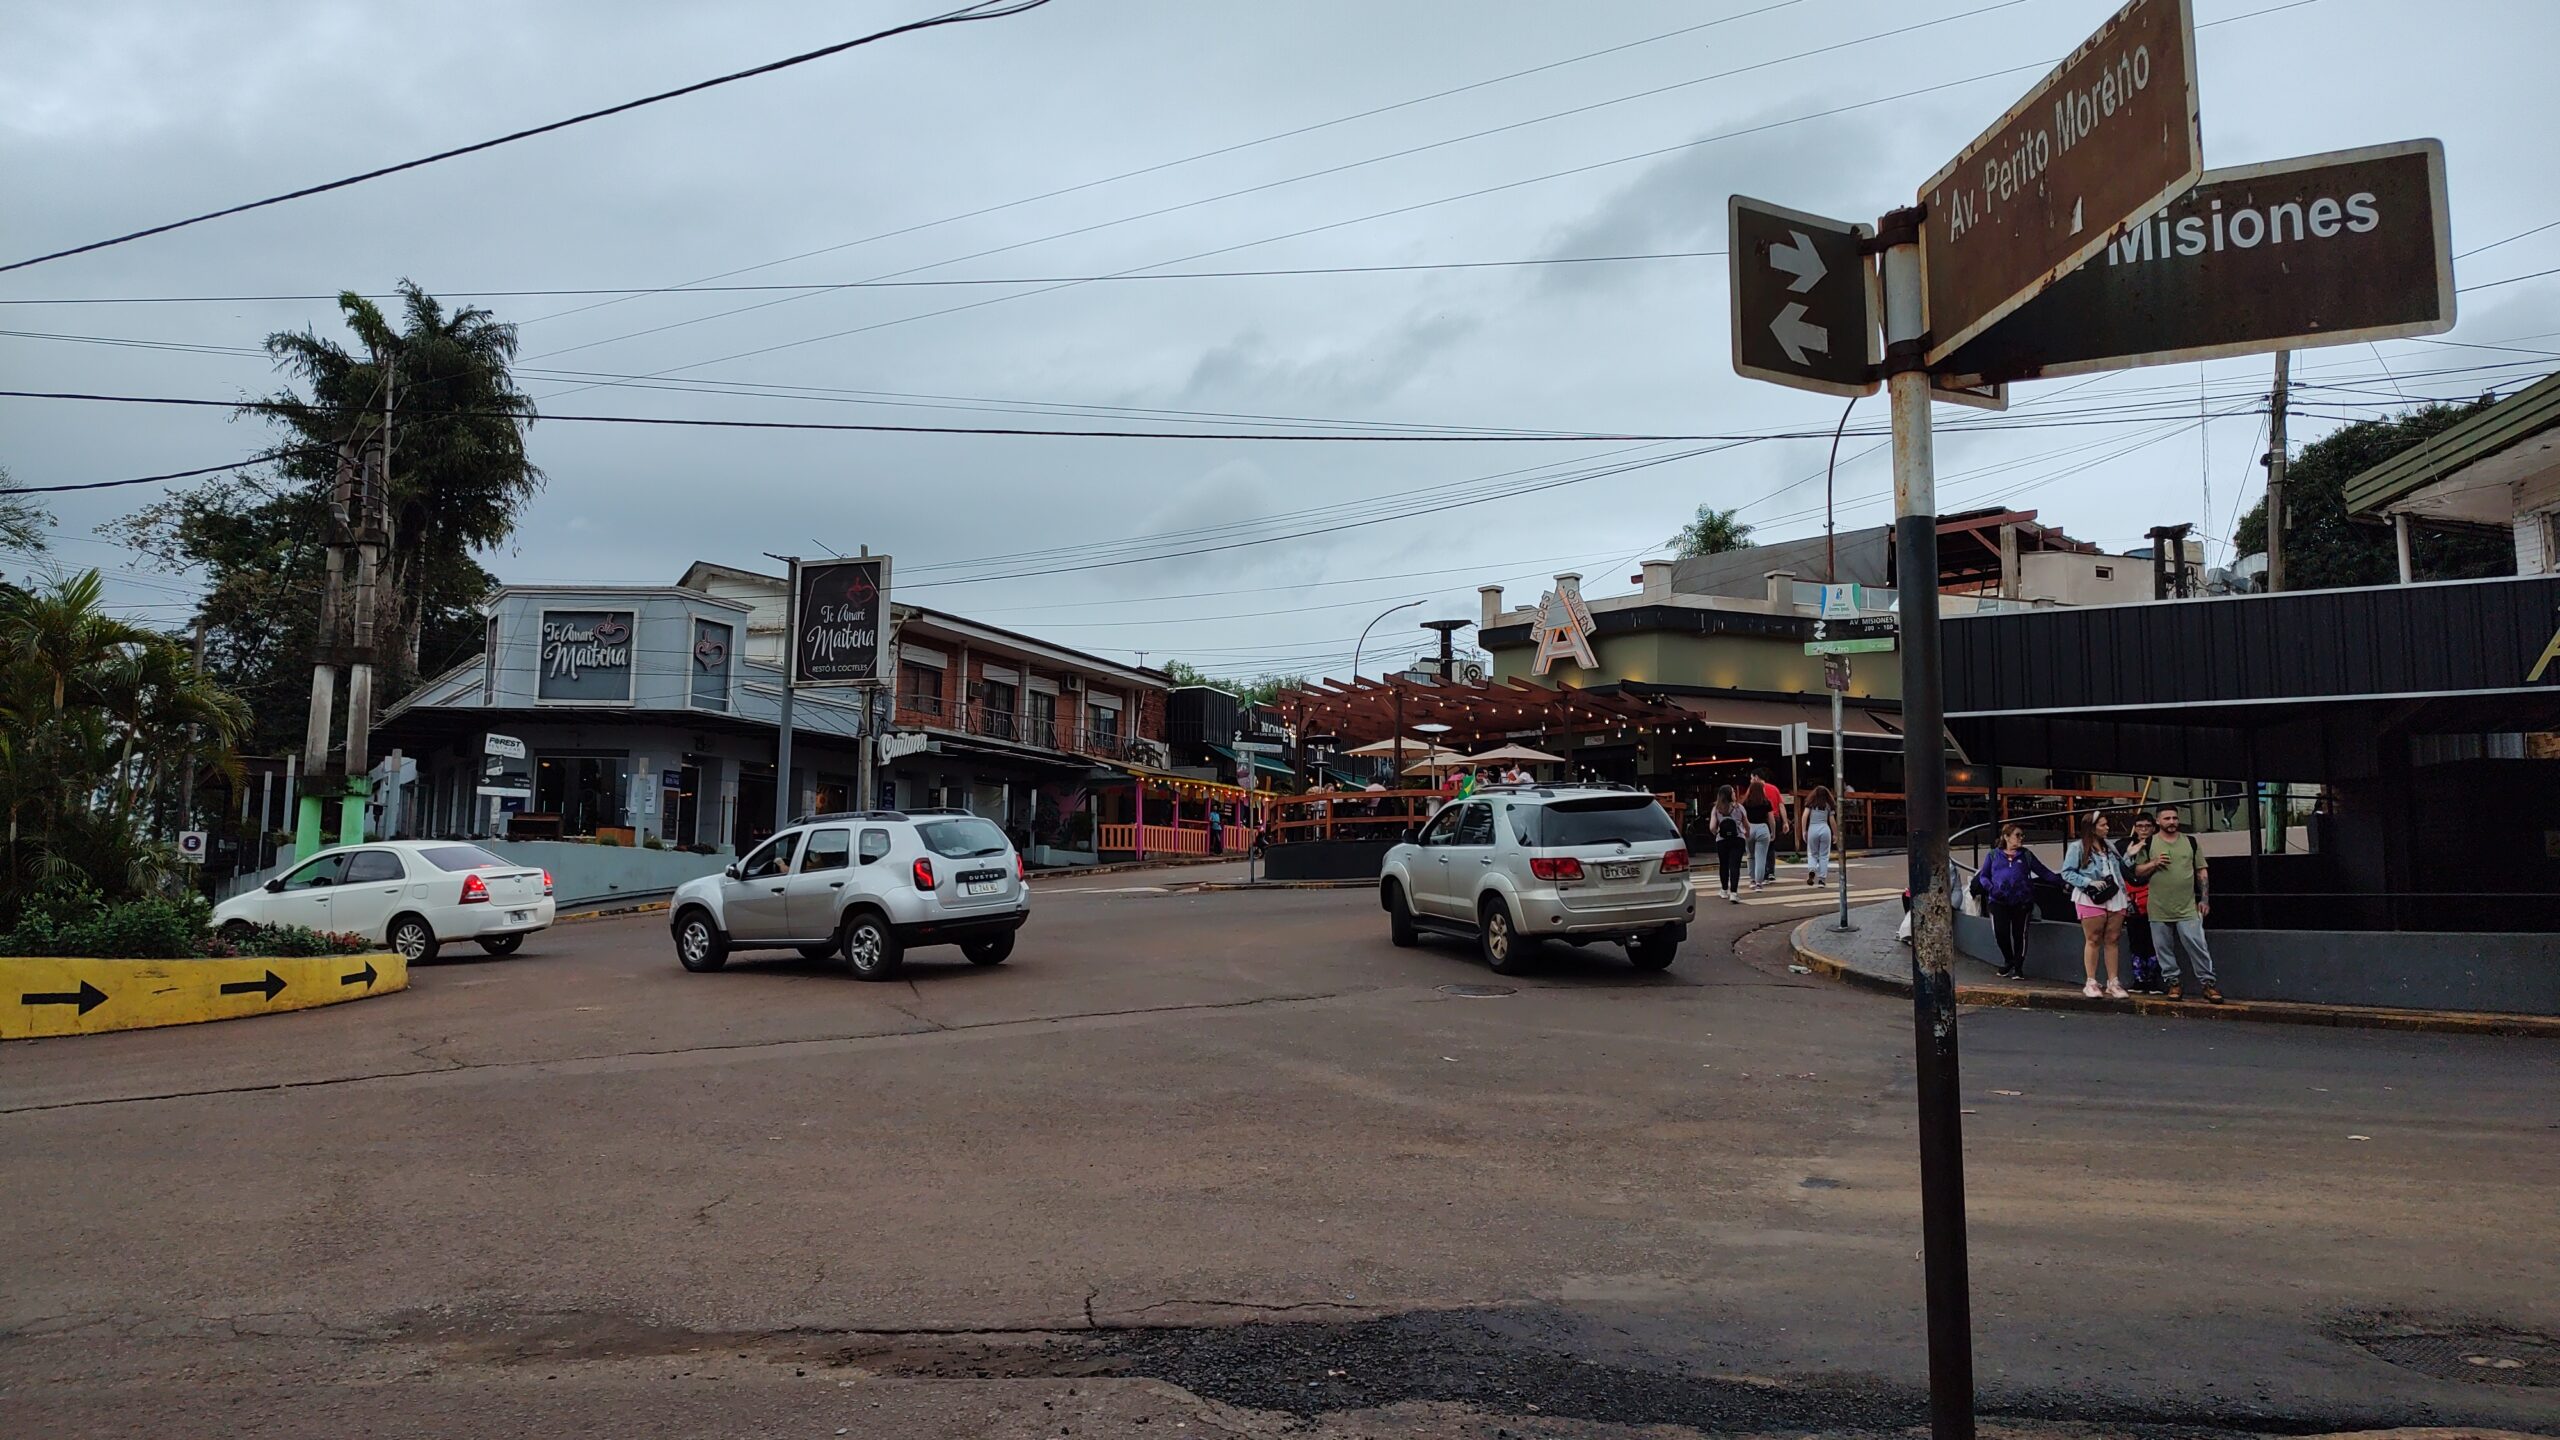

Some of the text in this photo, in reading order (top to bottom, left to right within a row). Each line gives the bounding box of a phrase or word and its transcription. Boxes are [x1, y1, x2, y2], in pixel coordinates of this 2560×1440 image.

[1950, 44, 2150, 243] Av. Perito Moreno
[2109, 192, 2379, 266] Misiones
[820, 604, 835, 624] Te
[1531, 594, 1551, 641] ANDES
[1861, 616, 1893, 625] MISIONES
[544, 622, 561, 642] Te
[806, 623, 875, 662] Maitena
[543, 640, 627, 680] Maitena
[837, 664, 868, 672] COCTELES
[489, 736, 521, 748] FOREST
[187, 839, 196, 848] E
[968, 873, 999, 881] DUSTER
